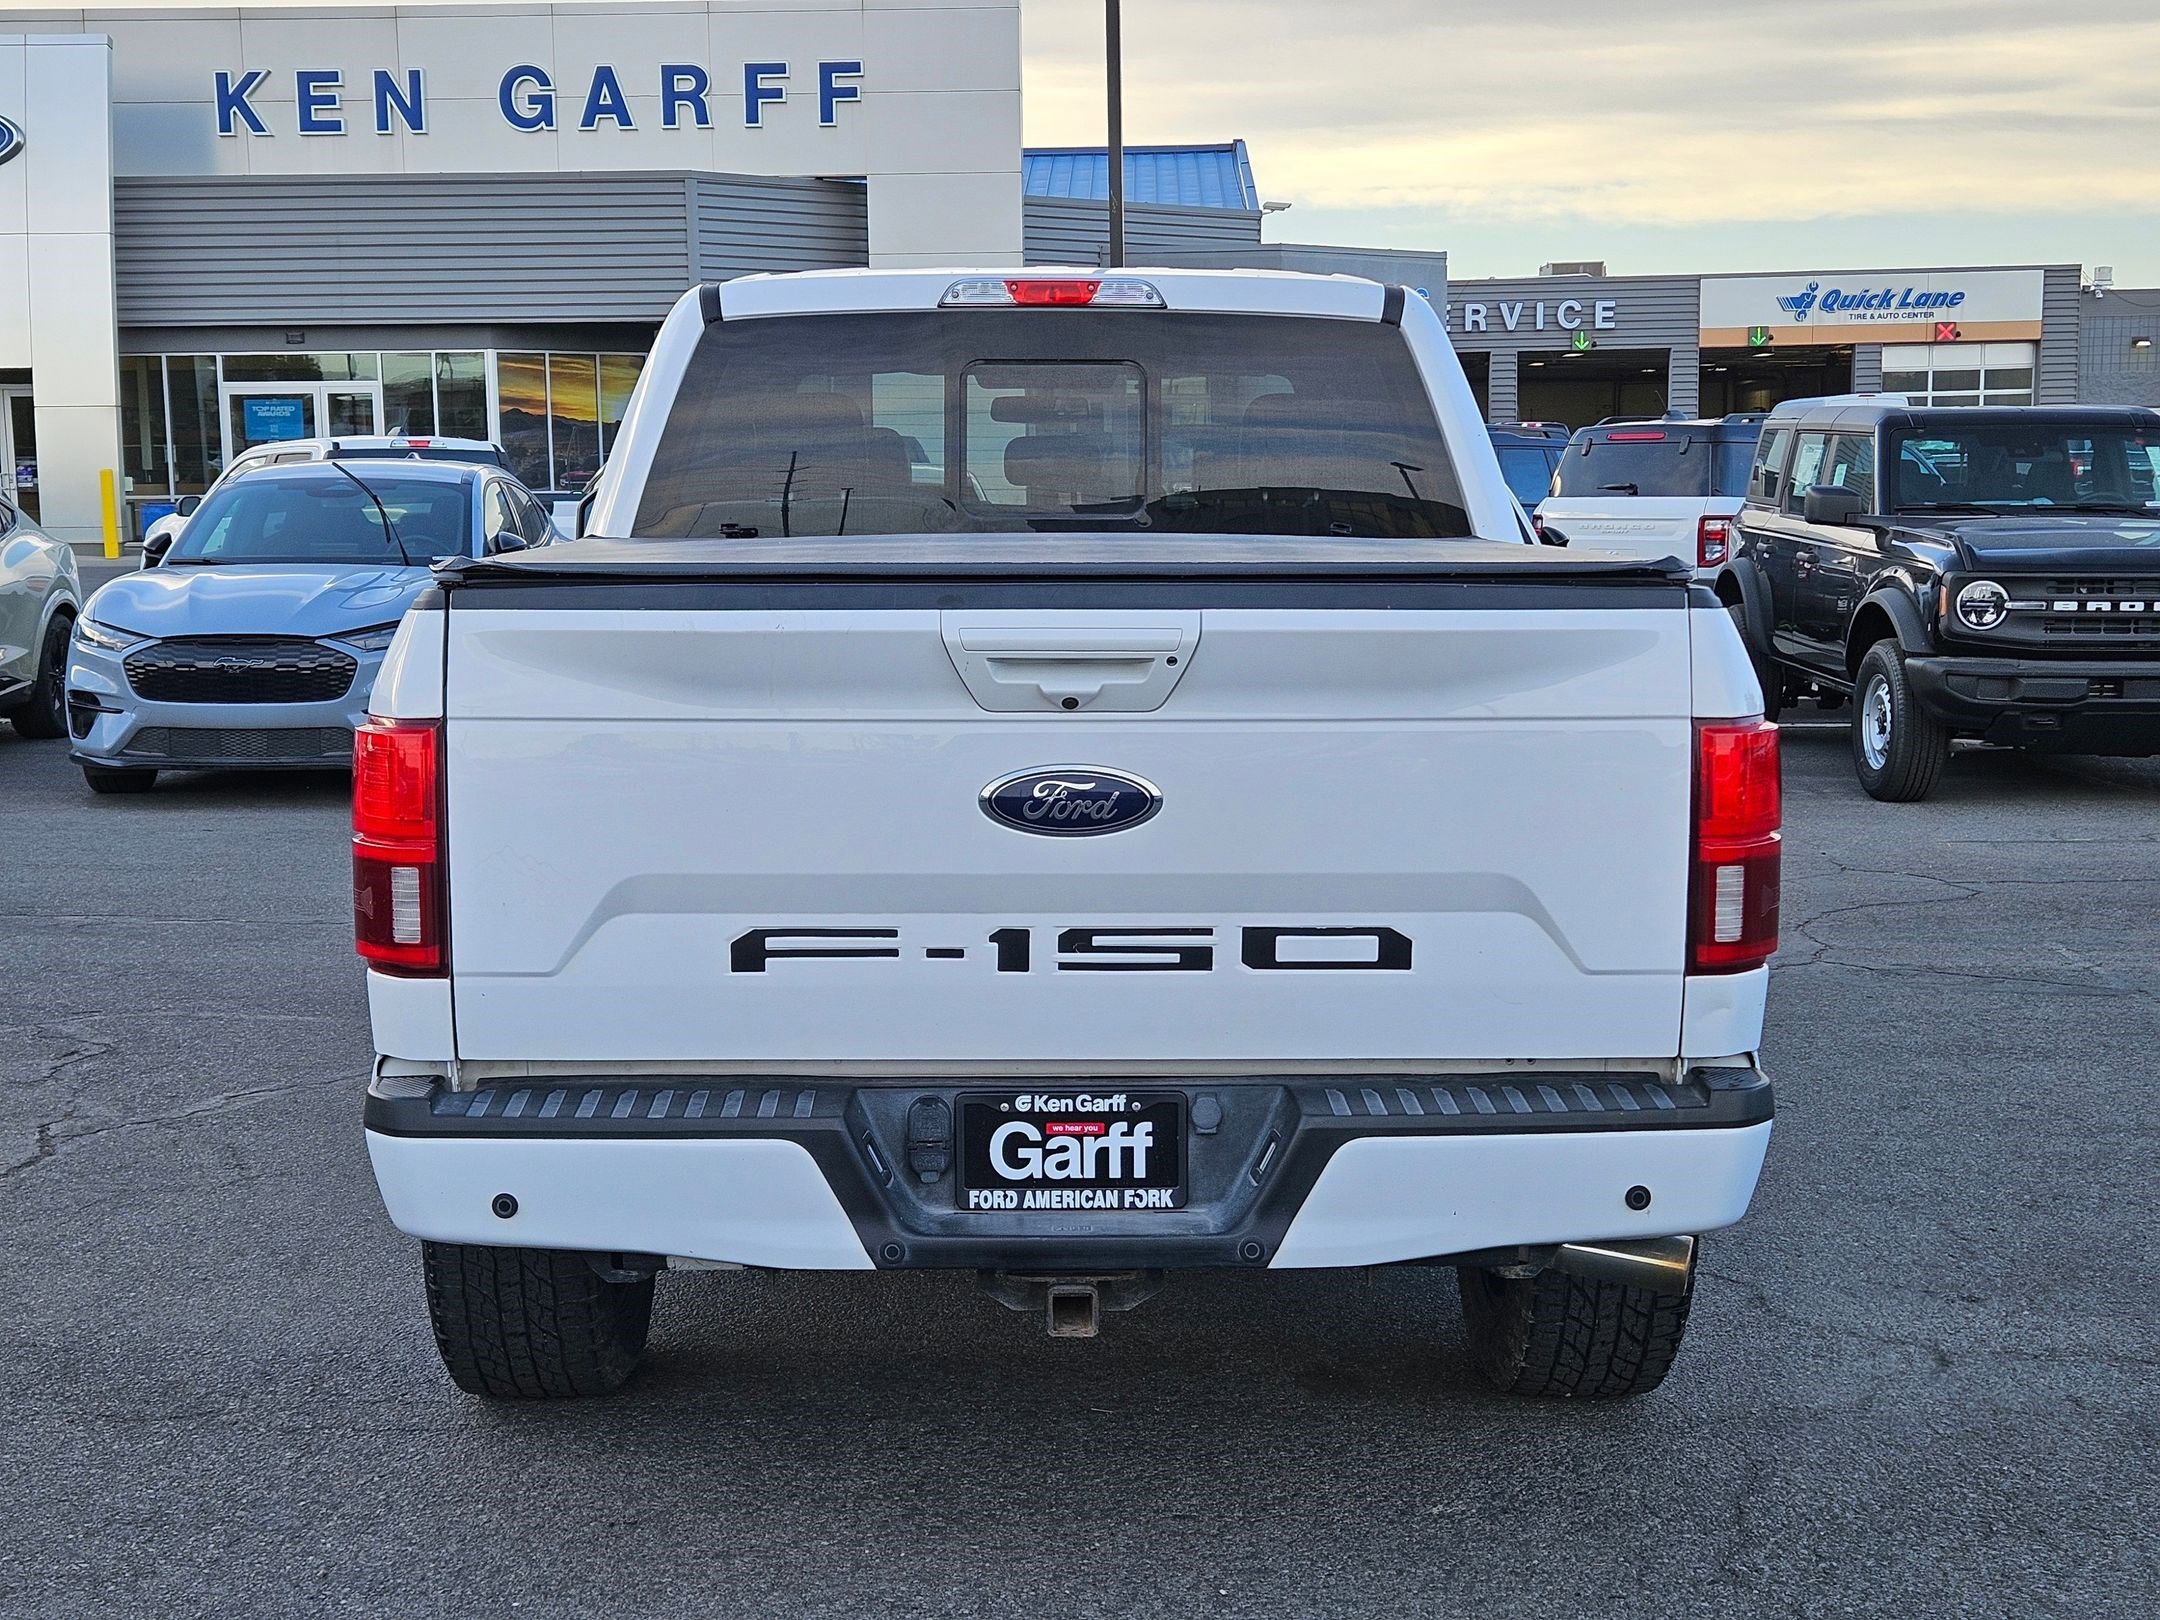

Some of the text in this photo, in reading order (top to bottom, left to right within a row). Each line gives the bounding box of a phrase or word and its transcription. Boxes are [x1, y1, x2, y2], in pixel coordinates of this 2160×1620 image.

[213, 59, 865, 137] KEN GARFF
[1820, 287, 1965, 312] Quick Lane
[1446, 300, 1617, 333] RVICE
[1877, 312, 1900, 320] AUTO
[1901, 311, 1935, 319] CENTER
[1022, 780, 1119, 820] Ford
[729, 926, 1413, 973] F-150
[1034, 1094, 1127, 1112] Ken Garff
[1052, 1123, 1098, 1134] we hear you
[989, 1120, 1153, 1181] Garff
[969, 1189, 1174, 1209] FORD AMERICAN FORK
